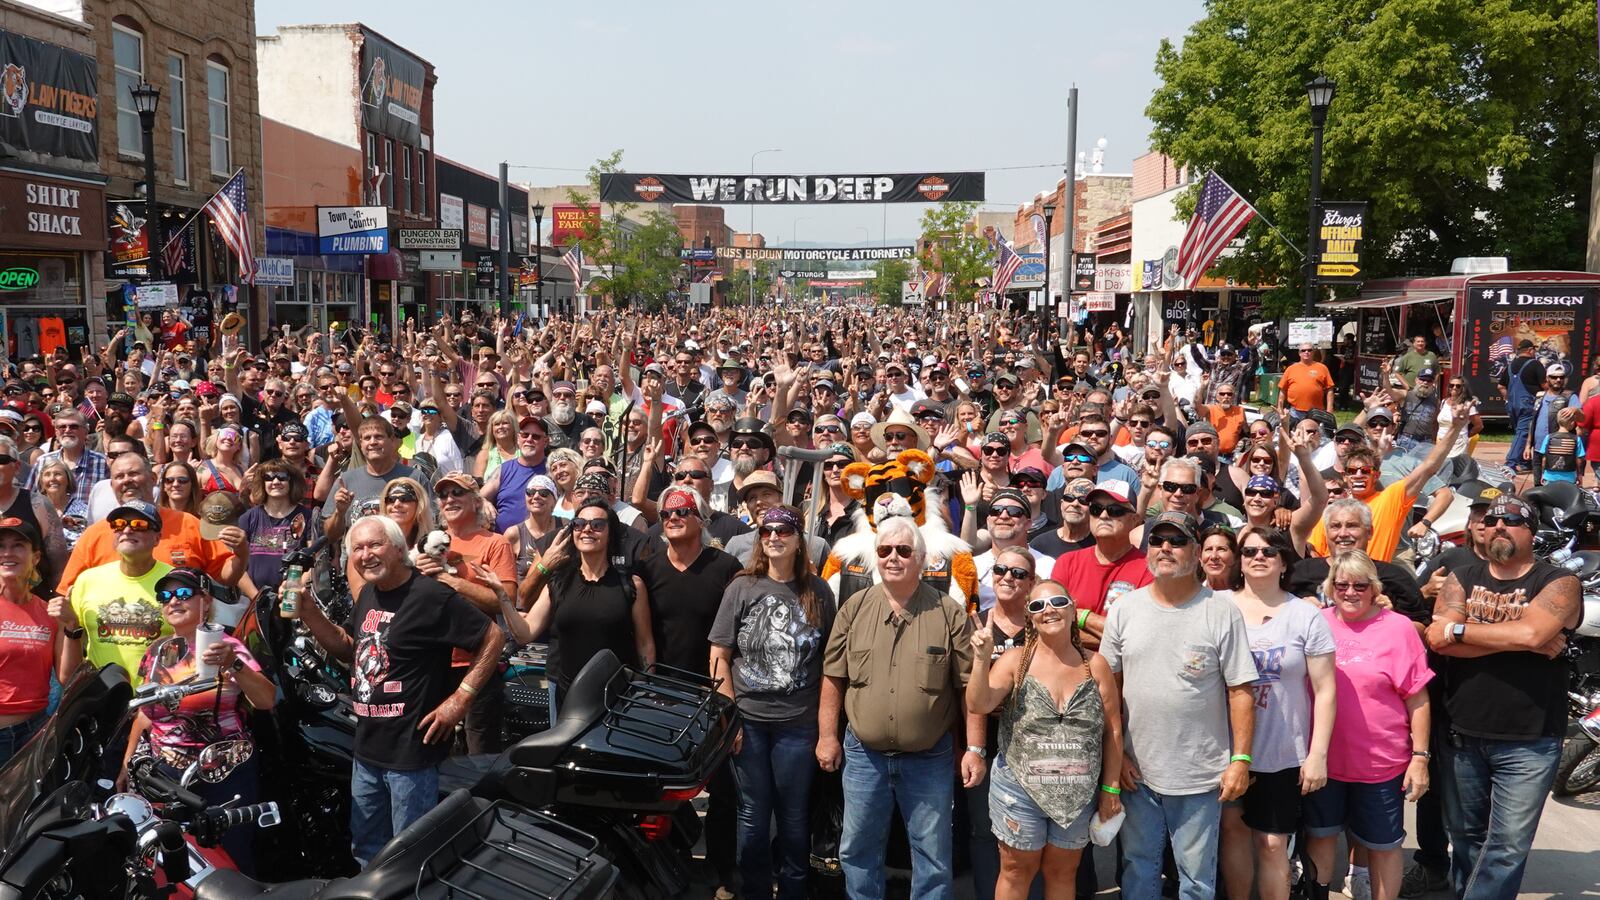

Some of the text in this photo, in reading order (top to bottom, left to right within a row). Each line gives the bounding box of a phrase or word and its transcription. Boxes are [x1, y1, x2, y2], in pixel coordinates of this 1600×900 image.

[60, 88, 97, 119] TIGERS
[26, 183, 80, 208] SHIRT
[689, 177, 894, 200] WE RUN DEEP
[27, 211, 81, 235] SHACK
[328, 212, 347, 223] Town
[348, 217, 377, 230] Country
[1322, 211, 1362, 228] Sturgis
[401, 230, 440, 238] DUNGEON
[1320, 226, 1363, 240] OFFICIAL
[332, 236, 384, 251] PLUMBING
[404, 237, 456, 245] DOWNSTAIRS
[1326, 240, 1355, 253] RALLY
[717, 247, 742, 258] RUSS
[745, 249, 783, 260] BROWN
[783, 250, 850, 260] MOTORCYCLE
[852, 248, 911, 259] ATTORNEYS
[260, 259, 292, 276] WebCam
[1094, 267, 1131, 277] eakfast
[0, 272, 34, 286] OPEN
[1104, 280, 1124, 290] Day
[1235, 293, 1262, 303] Trum
[1482, 289, 1510, 305] #1
[1490, 311, 1575, 333] STURGIS
[1, 621, 51, 634] Sturgis
[369, 702, 405, 718] RALLY
[1037, 742, 1082, 750] STURGIS
